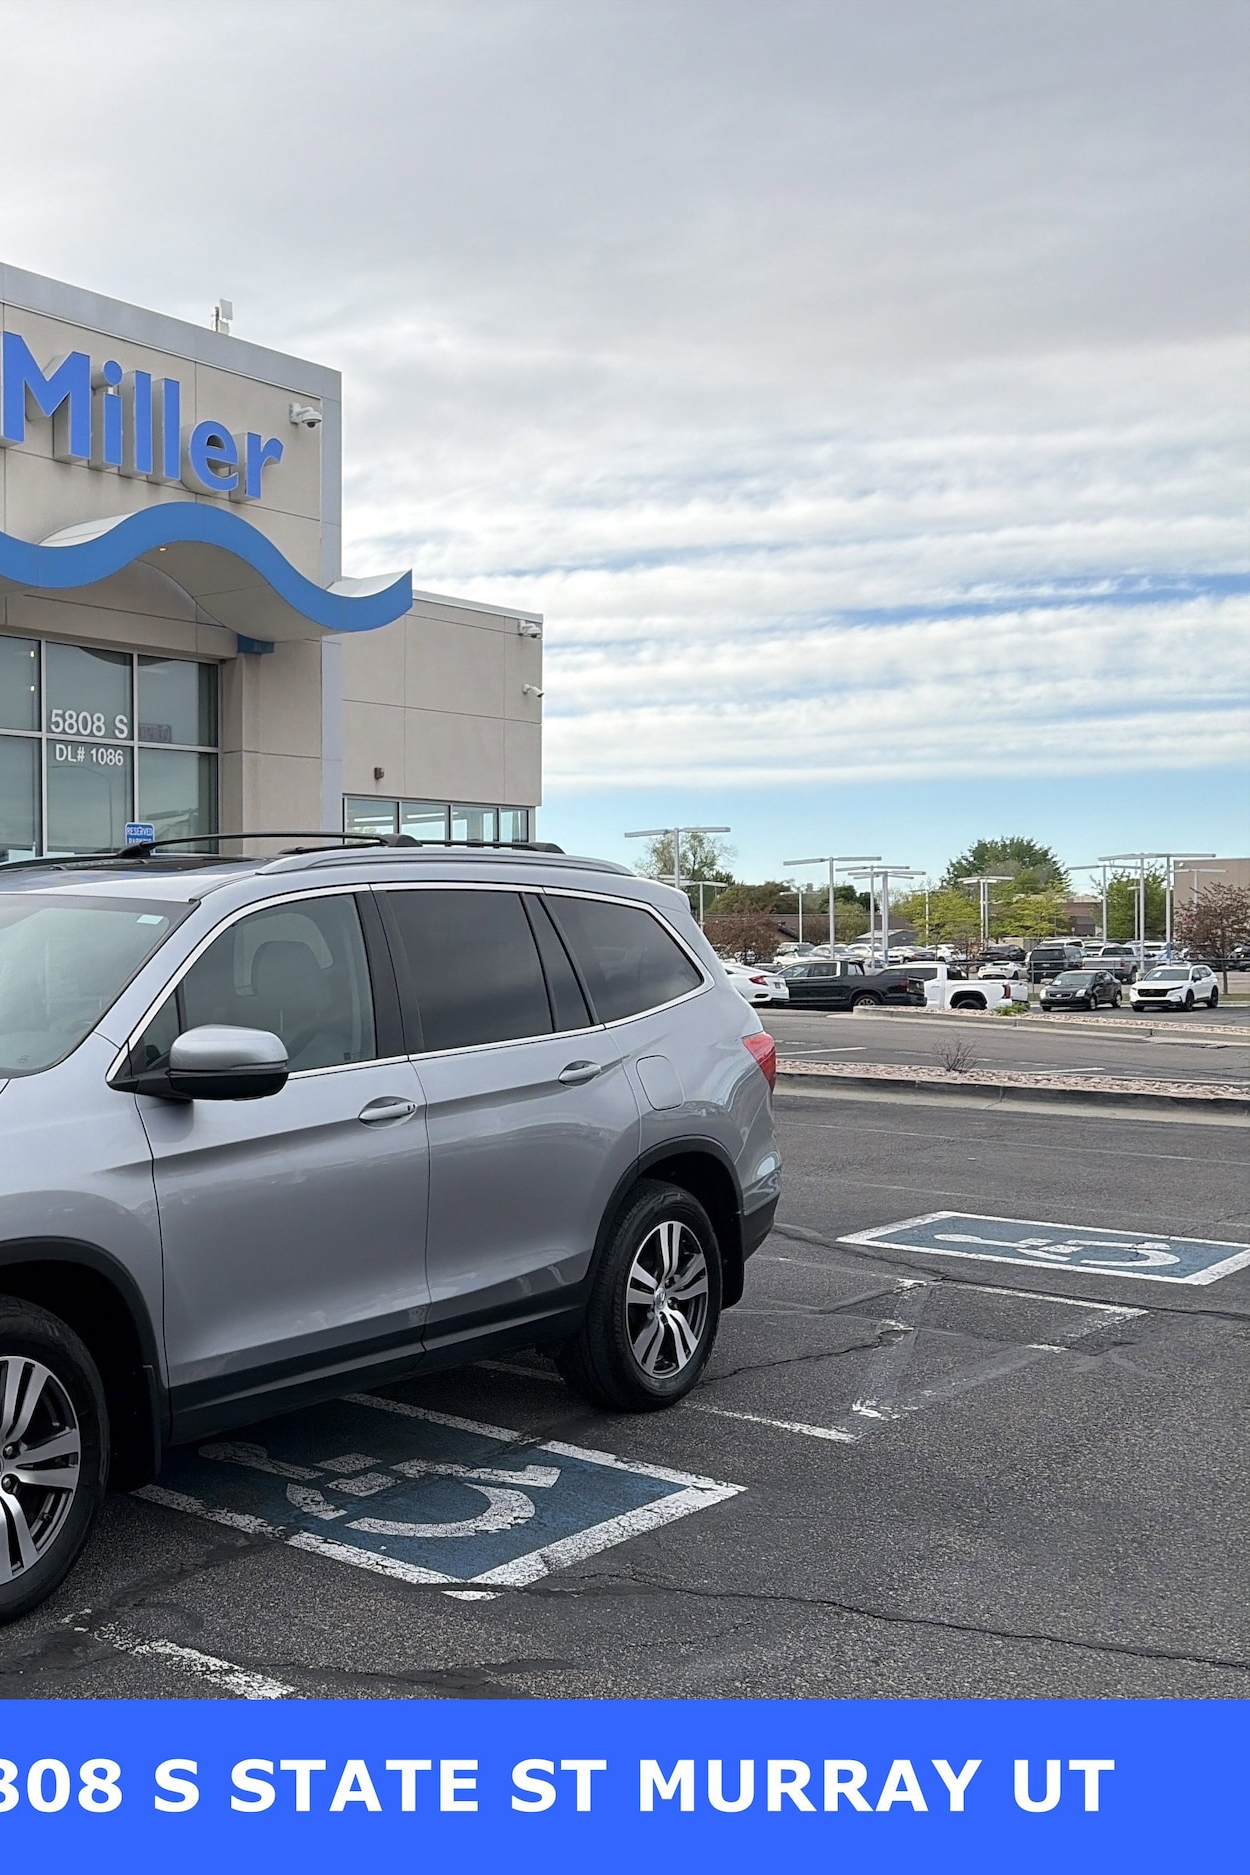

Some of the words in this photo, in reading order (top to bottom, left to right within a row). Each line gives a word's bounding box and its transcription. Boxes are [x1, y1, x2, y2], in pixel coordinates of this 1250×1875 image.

[50, 708, 106, 737] 5808
[114, 714, 129, 739] S
[55, 743, 86, 762] DL#
[90, 747, 124, 766] 1086
